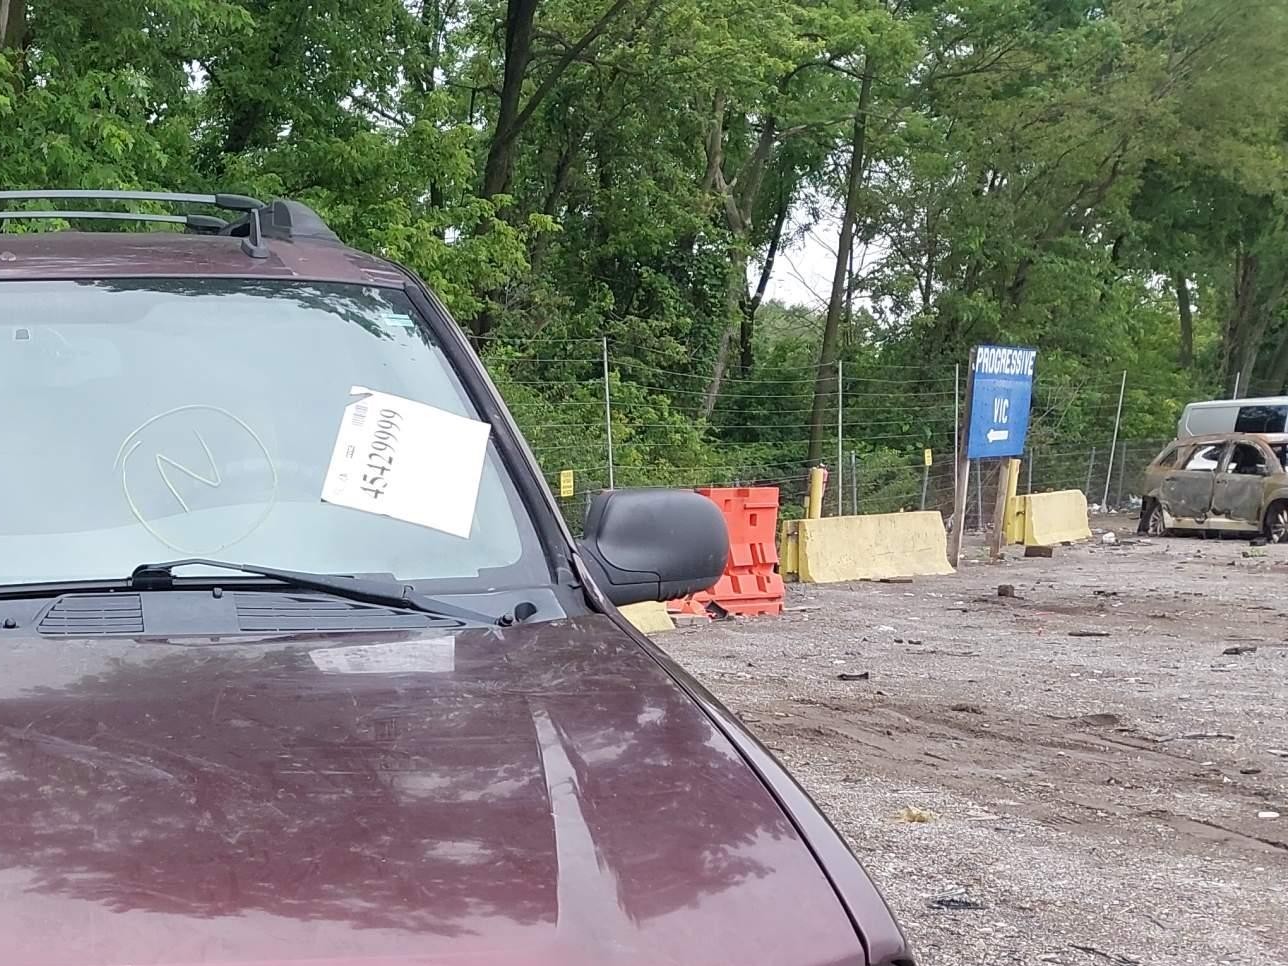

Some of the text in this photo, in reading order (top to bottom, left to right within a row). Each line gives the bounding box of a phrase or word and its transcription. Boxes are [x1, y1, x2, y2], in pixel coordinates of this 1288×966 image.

[975, 347, 1037, 376] PROGRESSIVE
[993, 397, 1009, 424] VIC
[360, 408, 403, 500] 45429999
